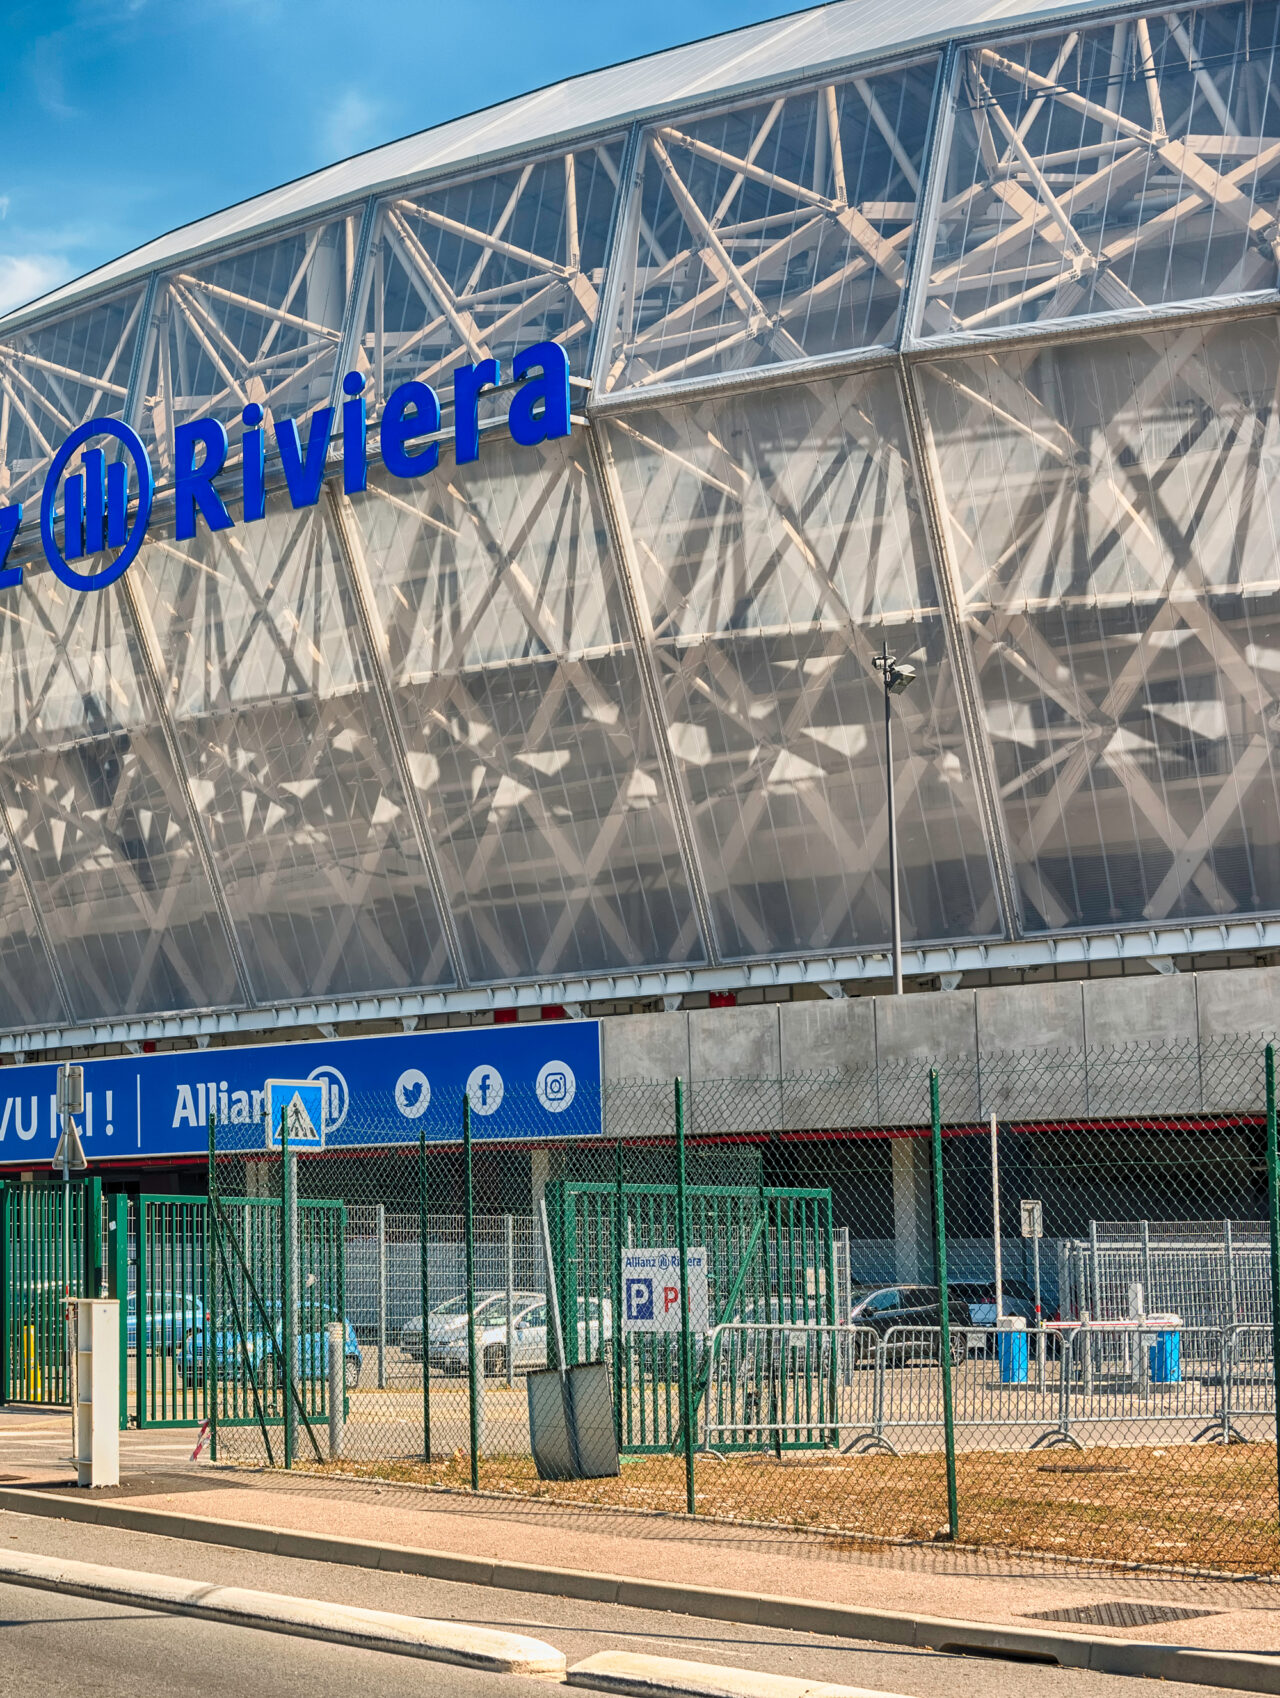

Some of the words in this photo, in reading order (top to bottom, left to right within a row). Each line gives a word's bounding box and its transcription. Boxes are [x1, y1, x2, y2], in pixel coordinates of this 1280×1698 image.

[174, 340, 571, 542] Riviera
[172, 1081, 266, 1128] Allian
[625, 1256, 656, 1268] Allianz
[671, 1256, 702, 1267] Riera
